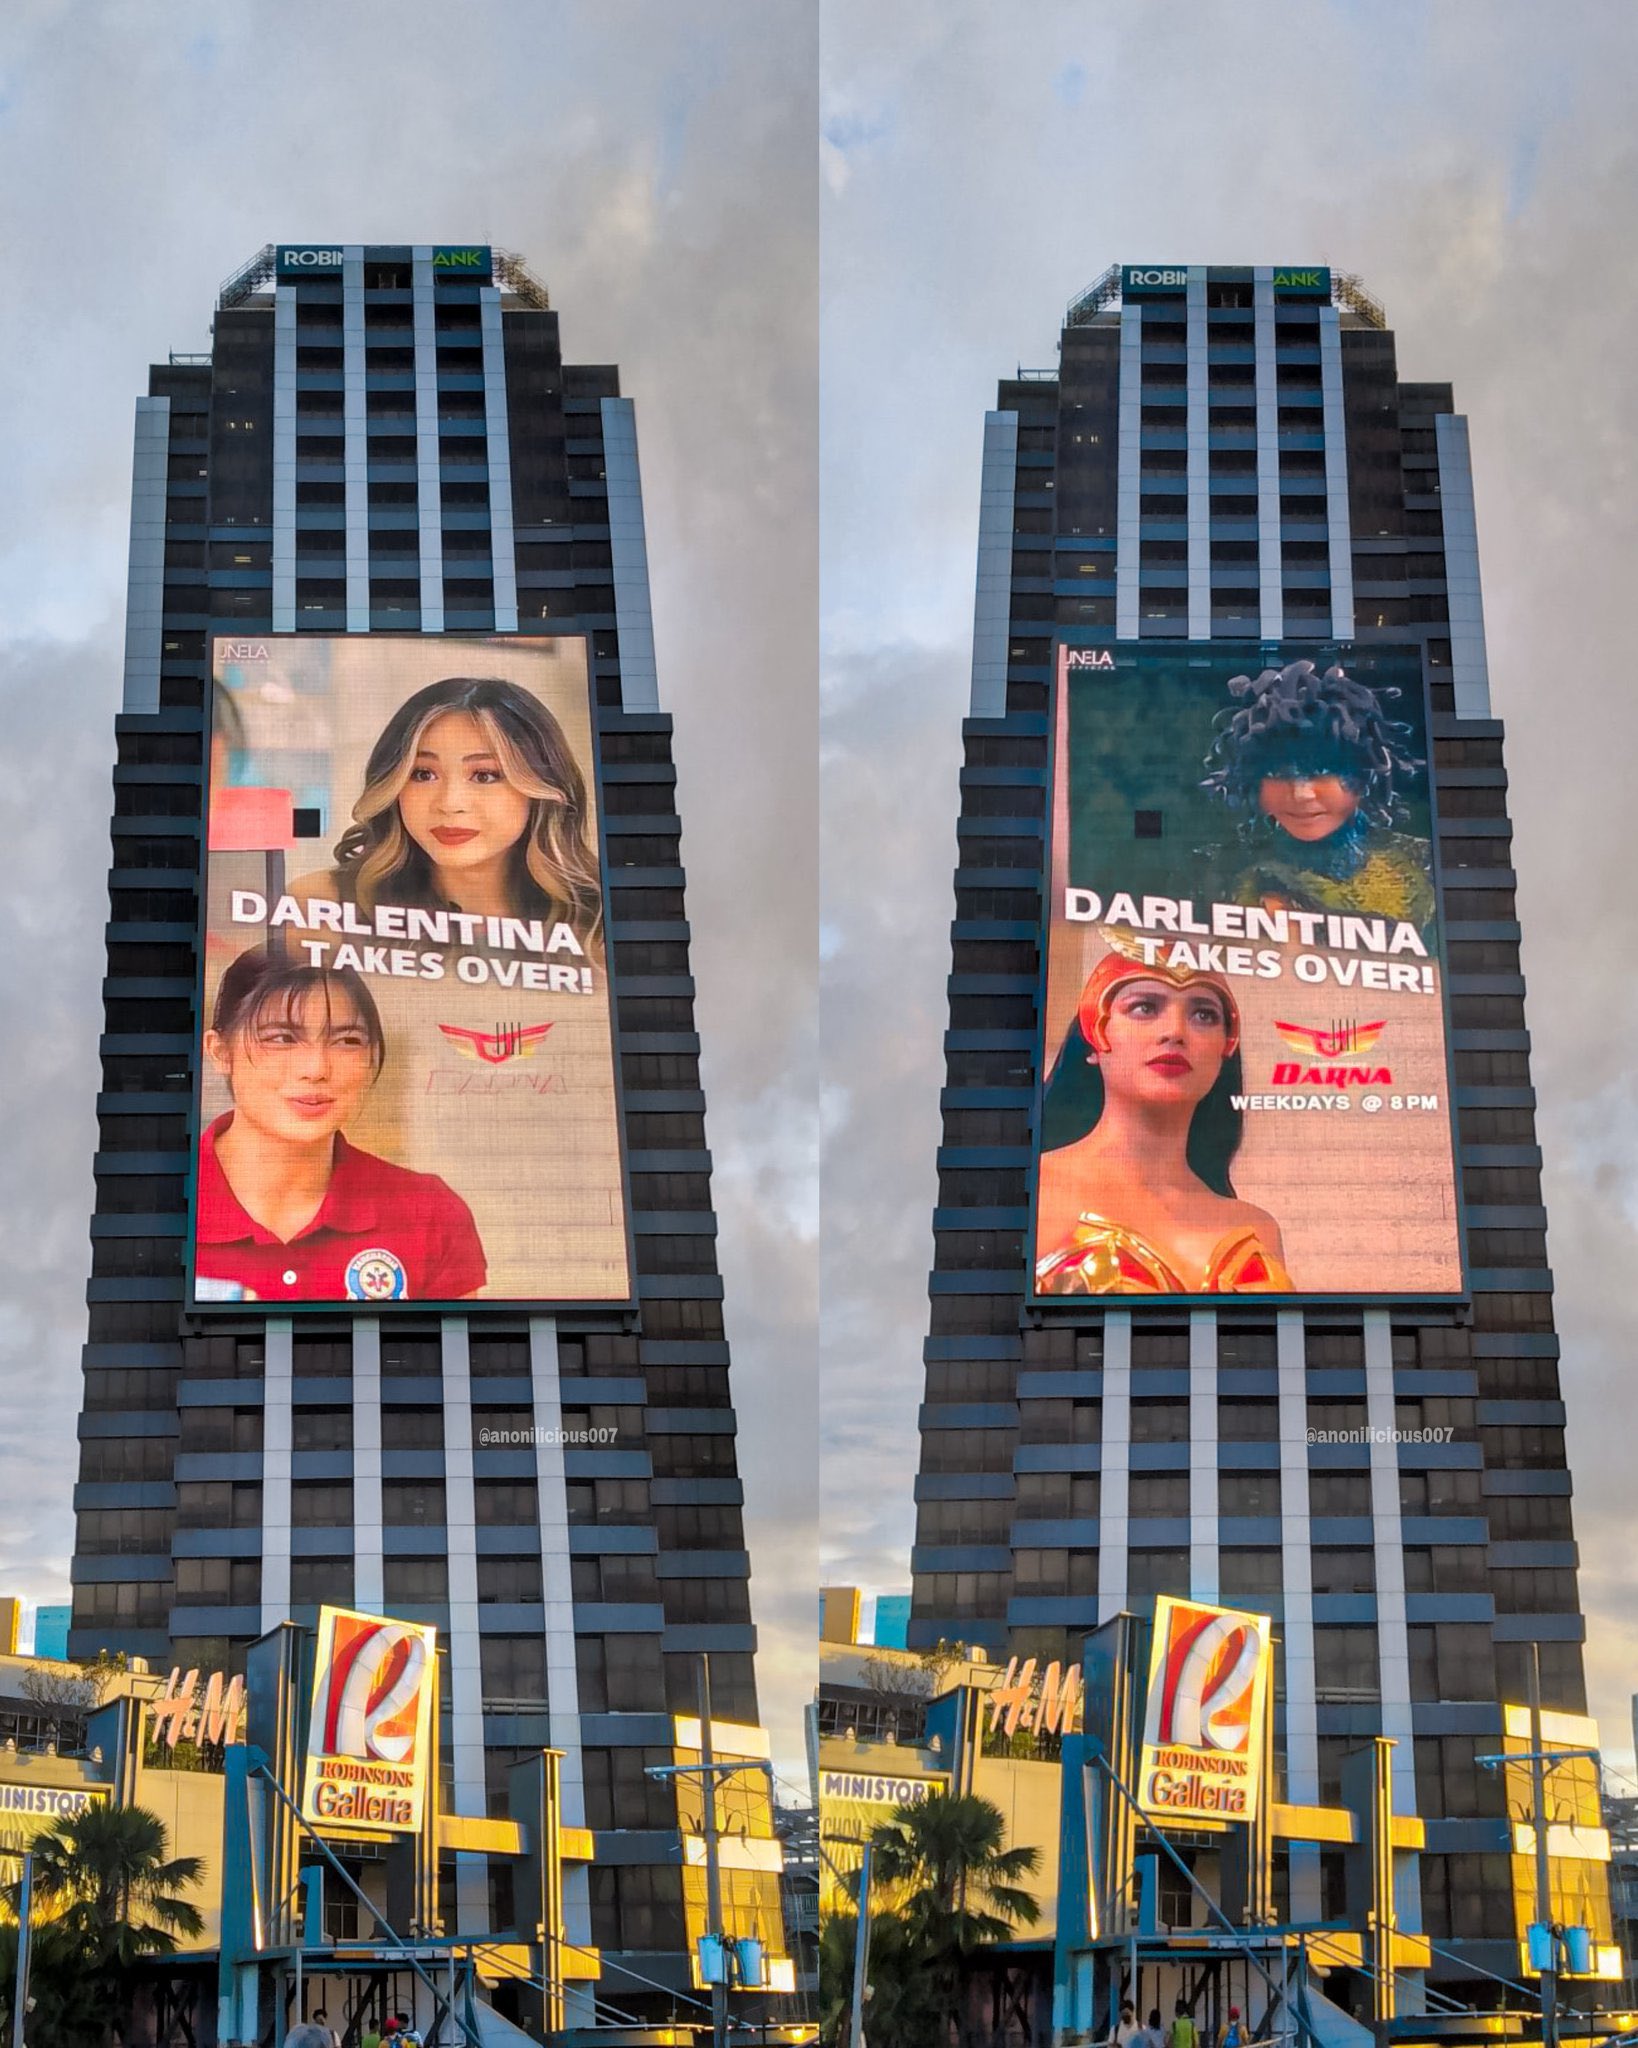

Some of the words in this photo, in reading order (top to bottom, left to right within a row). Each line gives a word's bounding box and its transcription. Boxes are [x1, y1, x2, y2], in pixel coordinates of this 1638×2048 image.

[1130, 270, 1187, 286] ROBI
[231, 890, 584, 956] DARLENTINA
[1065, 888, 1428, 957] DARLENTINA
[301, 939, 445, 981] TAKES
[457, 955, 593, 995] OVER!
[1134, 936, 1282, 979] TAKES
[1294, 954, 1435, 995] OVER!
[1271, 1063, 1393, 1089] DARNA
[1230, 1095, 1350, 1110] WEEKDAYS
[1361, 1095, 1382, 1111] @
[152, 1666, 244, 1748] H&M
[991, 1656, 1081, 1738] H&M
[318, 1760, 414, 1788] ROBINSONS
[1155, 1749, 1248, 1777] ROBINSONS
[316, 1781, 413, 1825] Galleria
[1151, 1770, 1247, 1813] Galleria
